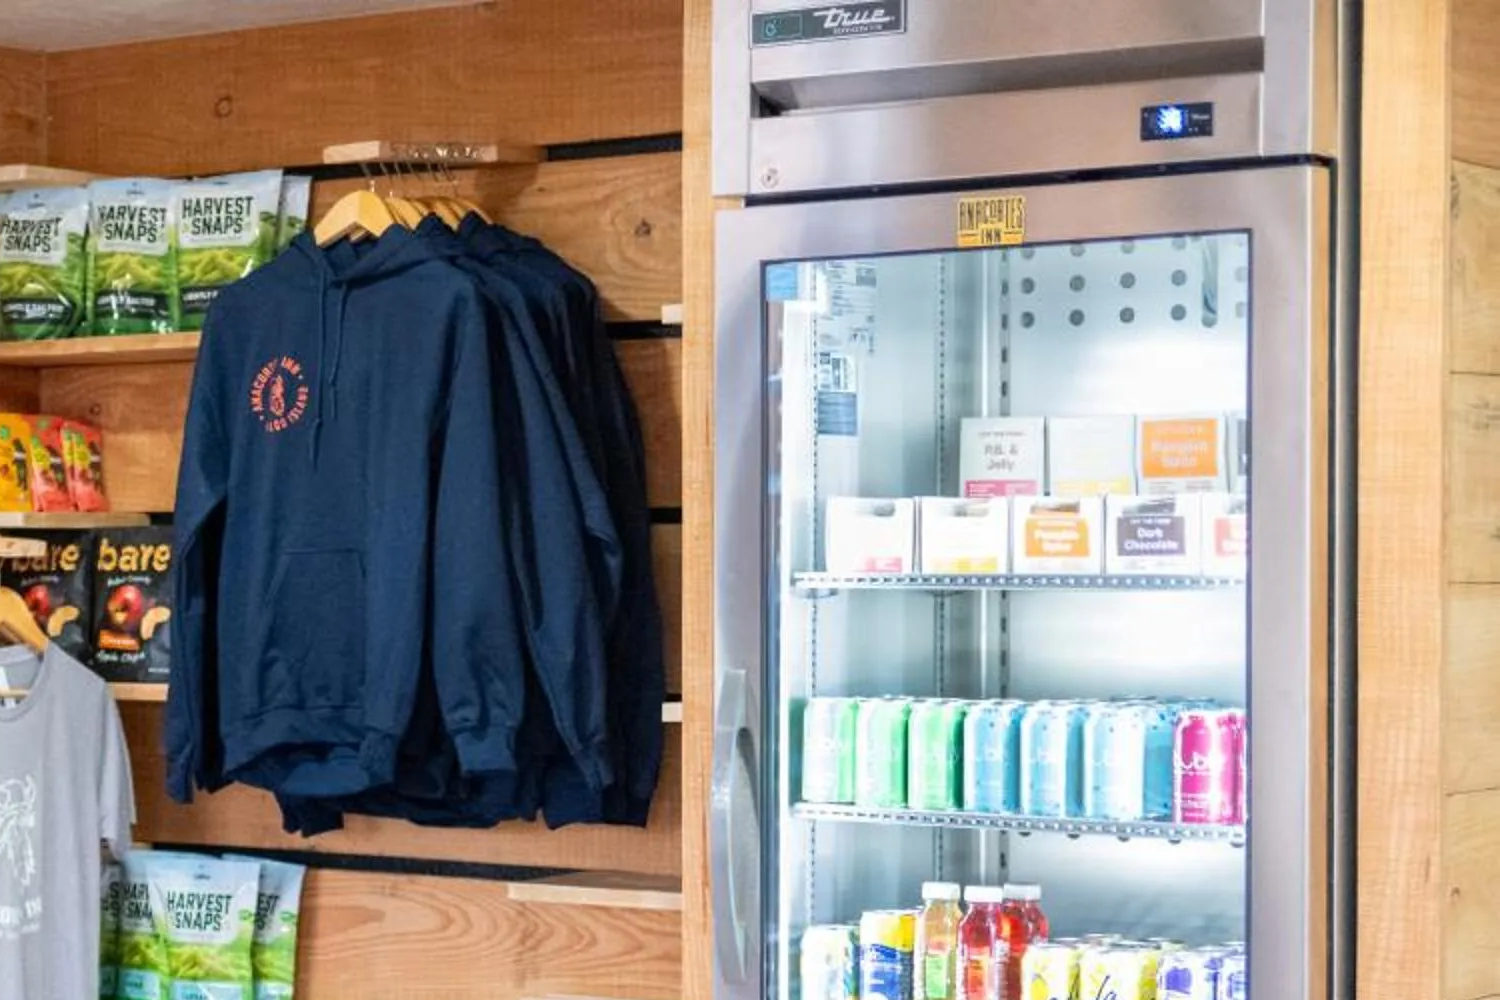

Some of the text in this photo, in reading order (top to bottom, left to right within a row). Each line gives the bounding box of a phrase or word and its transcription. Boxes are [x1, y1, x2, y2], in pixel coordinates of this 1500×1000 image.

[98, 206, 167, 227] HARVEST
[181, 196, 254, 218] HARVEST
[959, 197, 1023, 230] ANACORTES
[0, 217, 61, 238] HARVEST
[103, 222, 158, 244] SNAPS
[191, 214, 244, 236] SNAPS
[980, 227, 1003, 244] INN
[3, 234, 51, 253] SNAPS
[1136, 526, 1164, 539] Dark
[97, 538, 172, 572] bare
[1123, 538, 1180, 552] Chocolate
[126, 901, 153, 918] SNA
[167, 891, 233, 914] HARVEST
[175, 911, 223, 931] SNAPS
